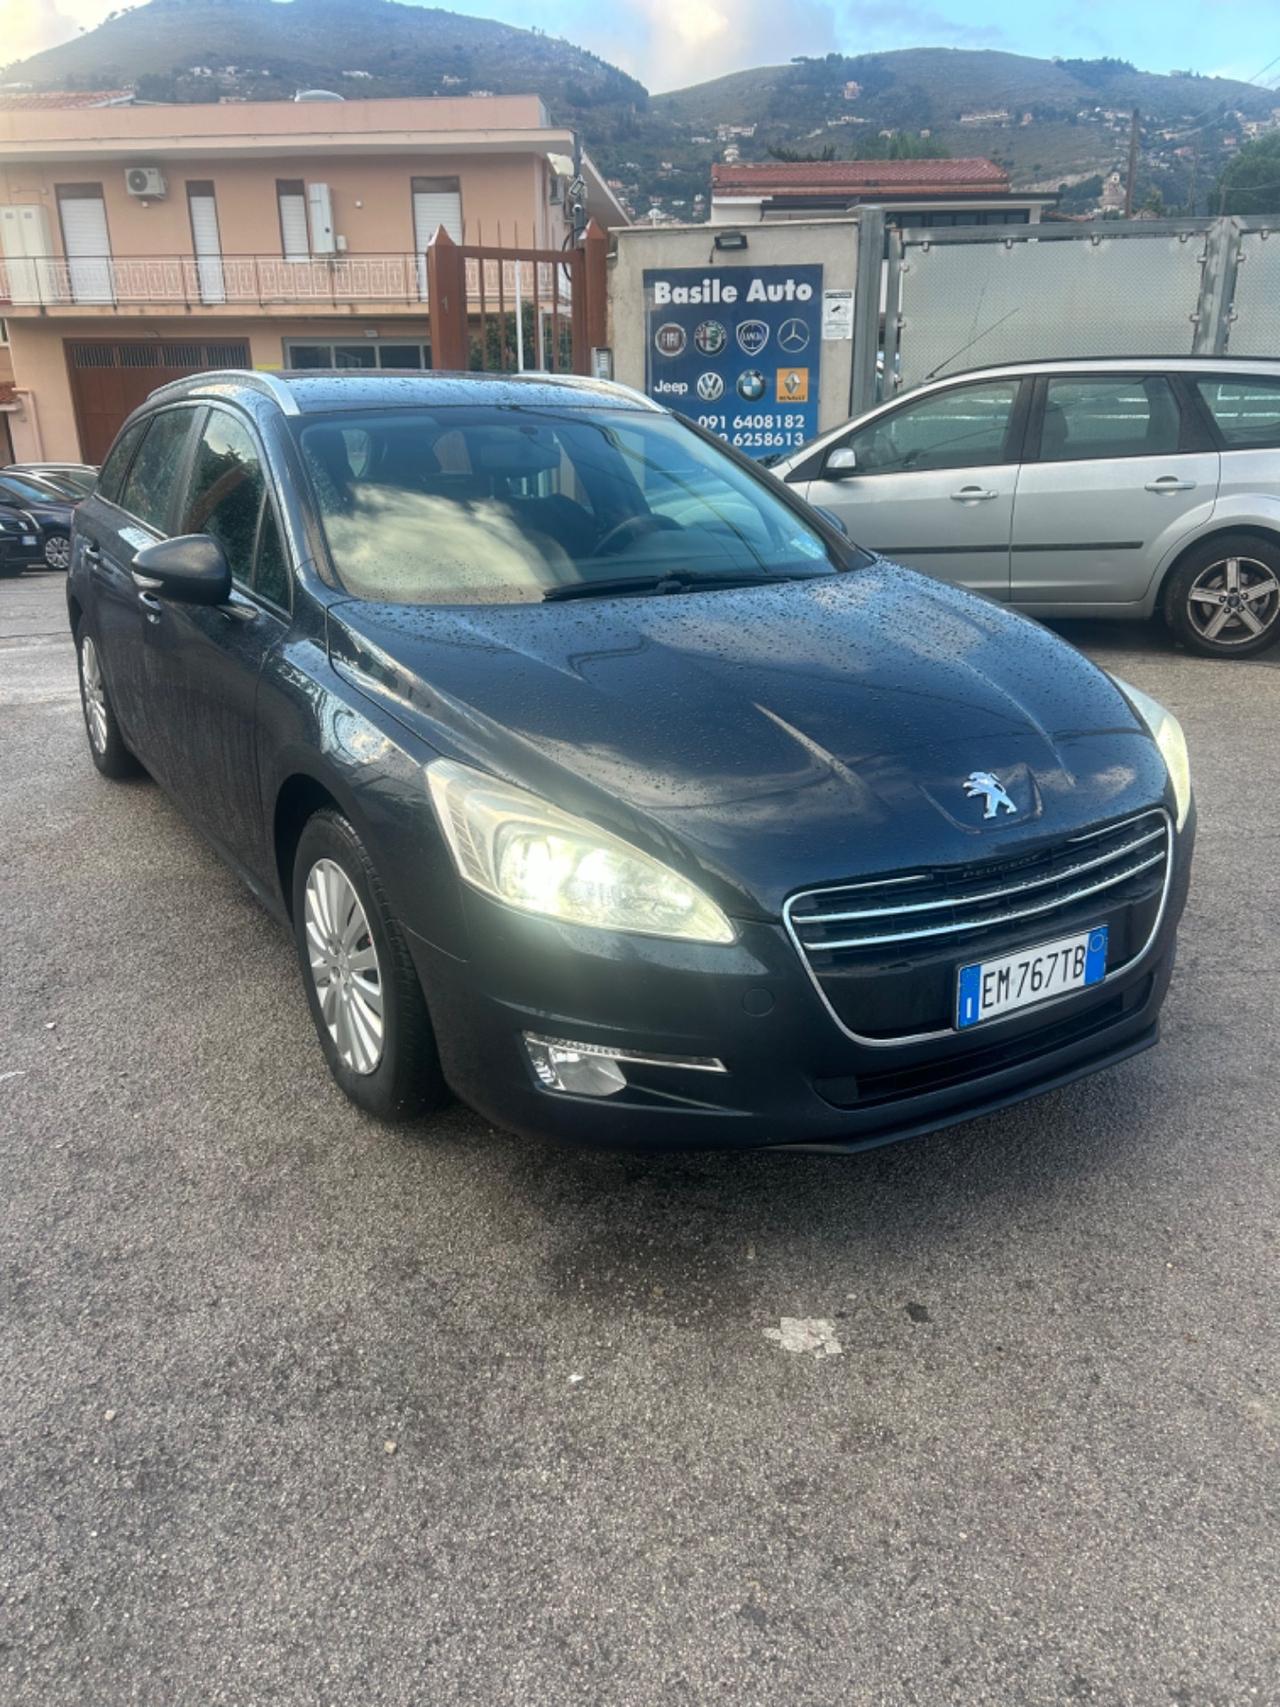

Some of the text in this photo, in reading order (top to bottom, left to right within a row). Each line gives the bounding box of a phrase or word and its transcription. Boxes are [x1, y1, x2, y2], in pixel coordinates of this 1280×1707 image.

[654, 279, 812, 304] Basile Auto
[654, 380, 688, 394] Jeep
[698, 414, 805, 429] 091 6408182
[732, 432, 804, 446] 6258613
